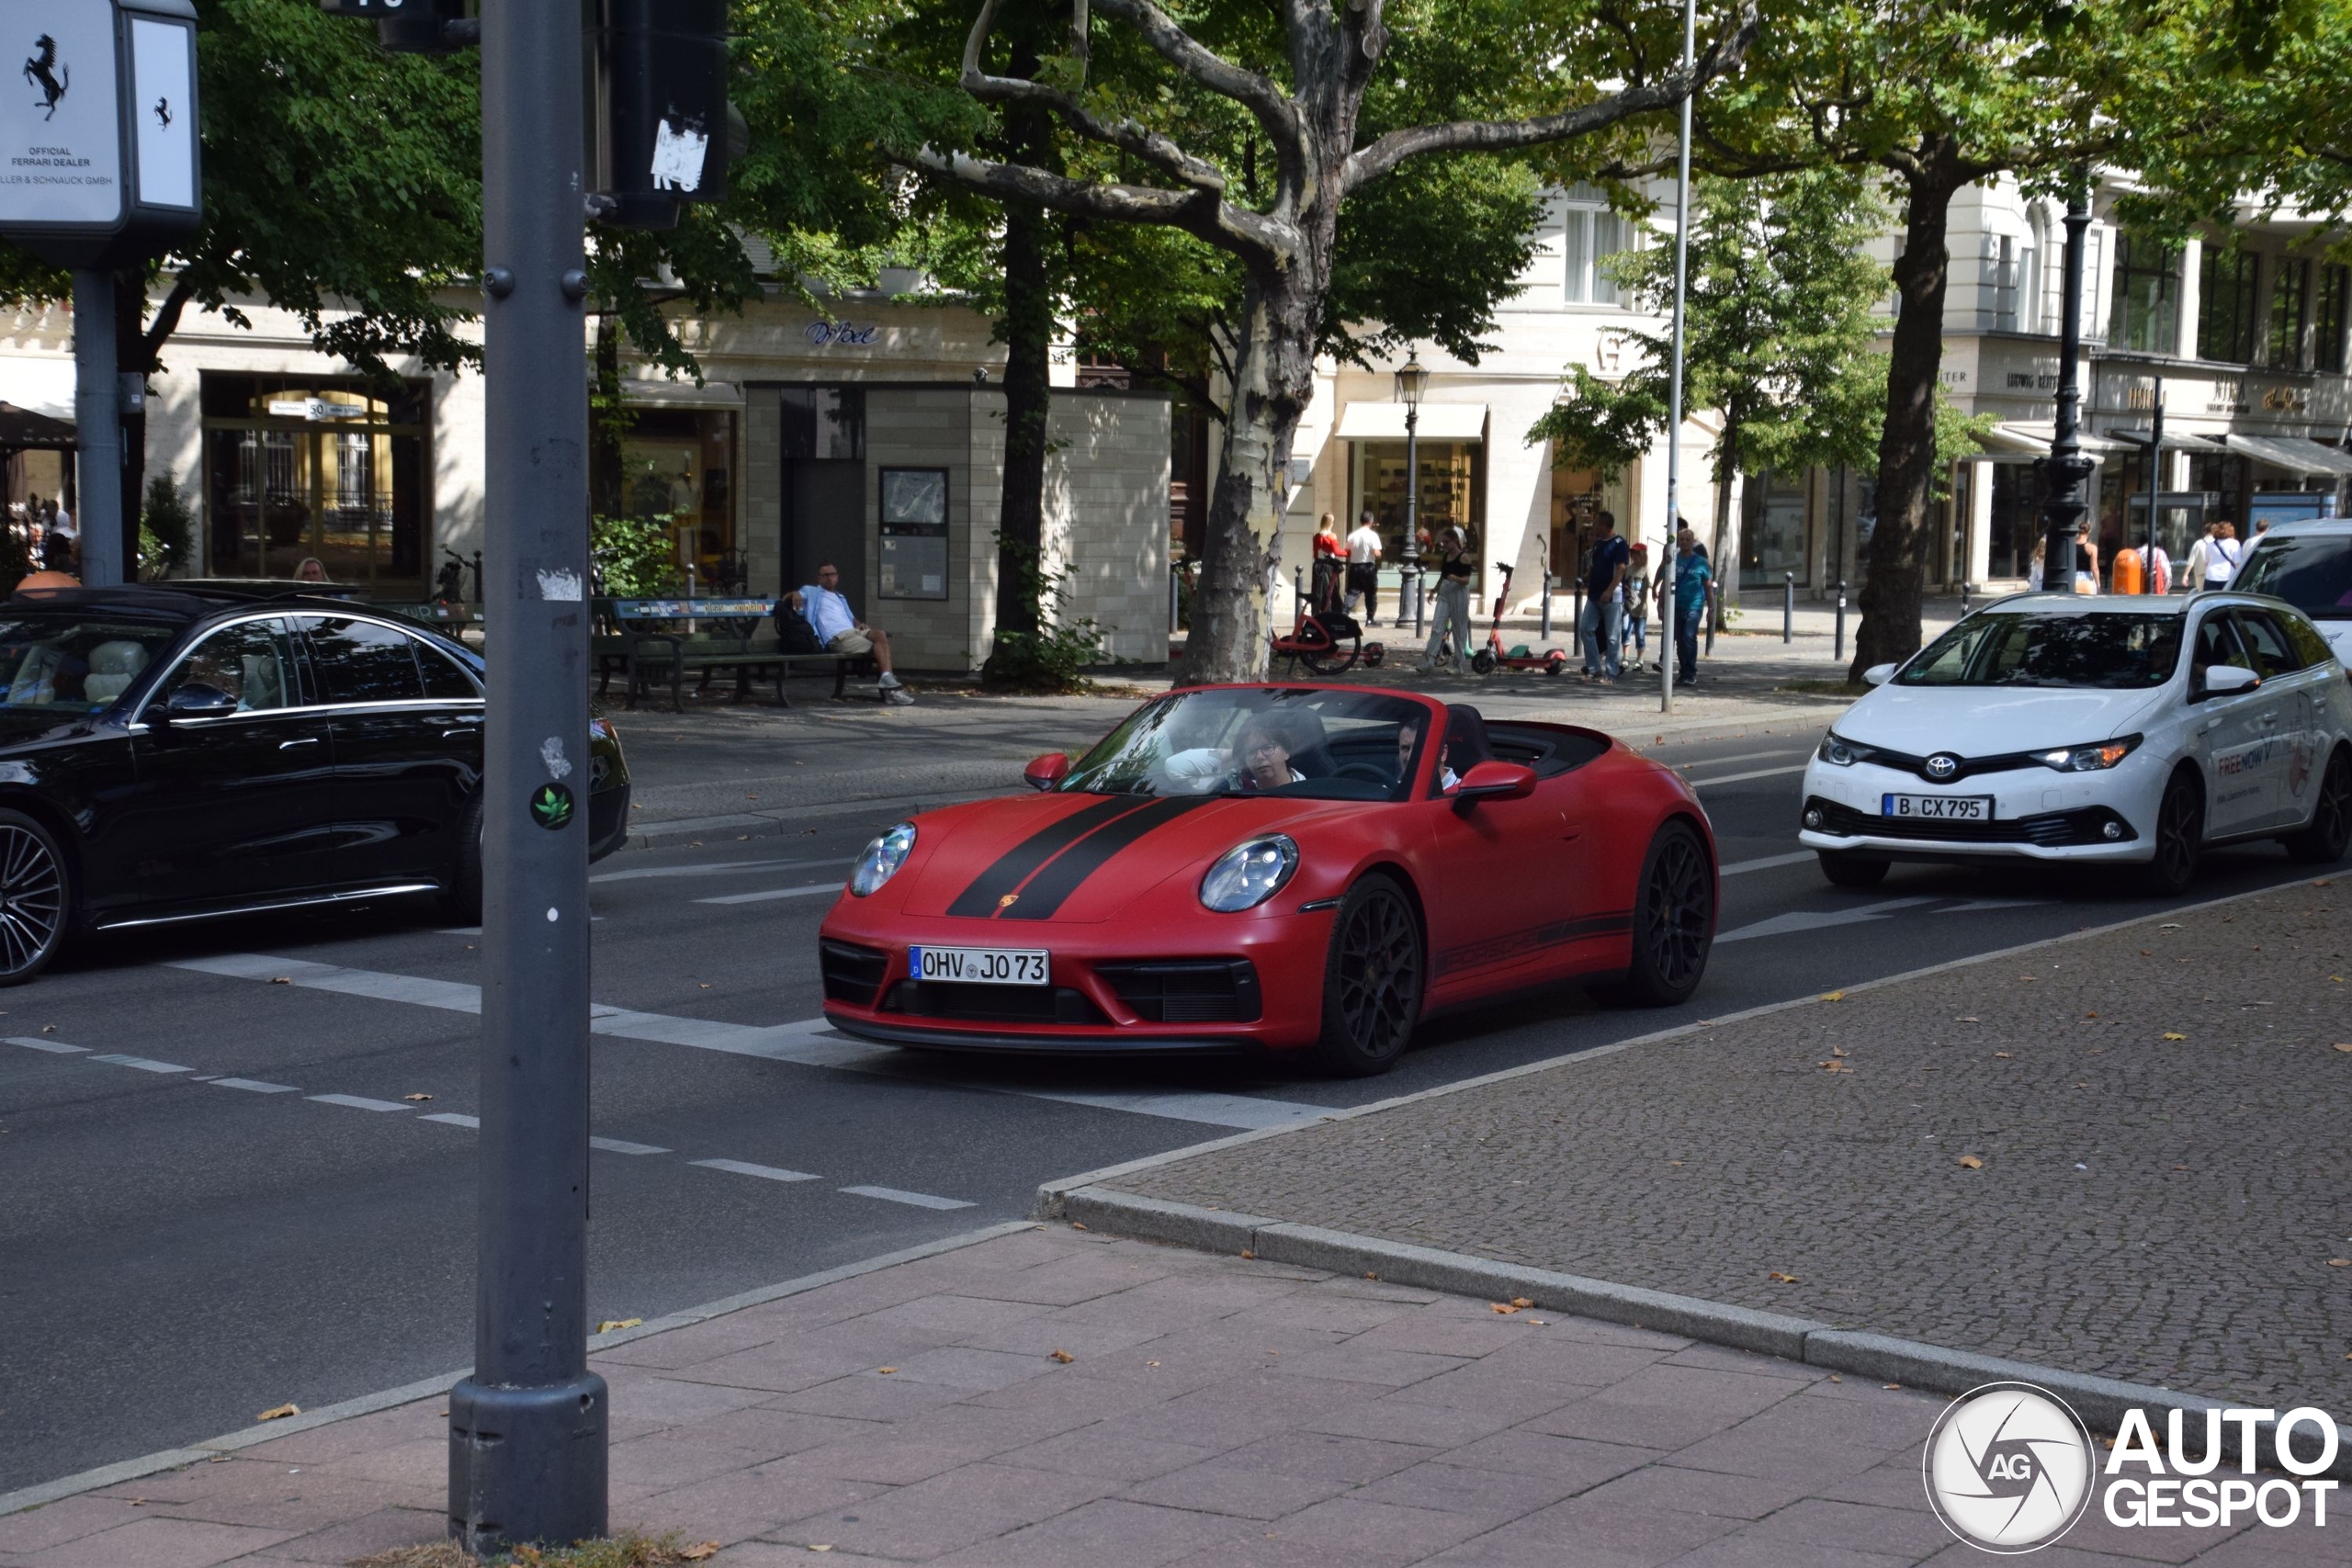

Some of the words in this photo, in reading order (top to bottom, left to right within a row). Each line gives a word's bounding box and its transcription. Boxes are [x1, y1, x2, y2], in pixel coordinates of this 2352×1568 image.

[28, 147, 71, 155] OFFICIAL
[11, 157, 51, 166] FERRARI
[53, 158, 90, 166] DEALER
[0, 175, 22, 185] LLER
[24, 175, 31, 185] &
[33, 175, 84, 185] SCHNAUCK
[85, 176, 112, 186] GMBH
[1899, 797, 1910, 815] B
[922, 952, 964, 977] OHV
[980, 954, 1010, 979] JO
[1015, 955, 1045, 980] 73
